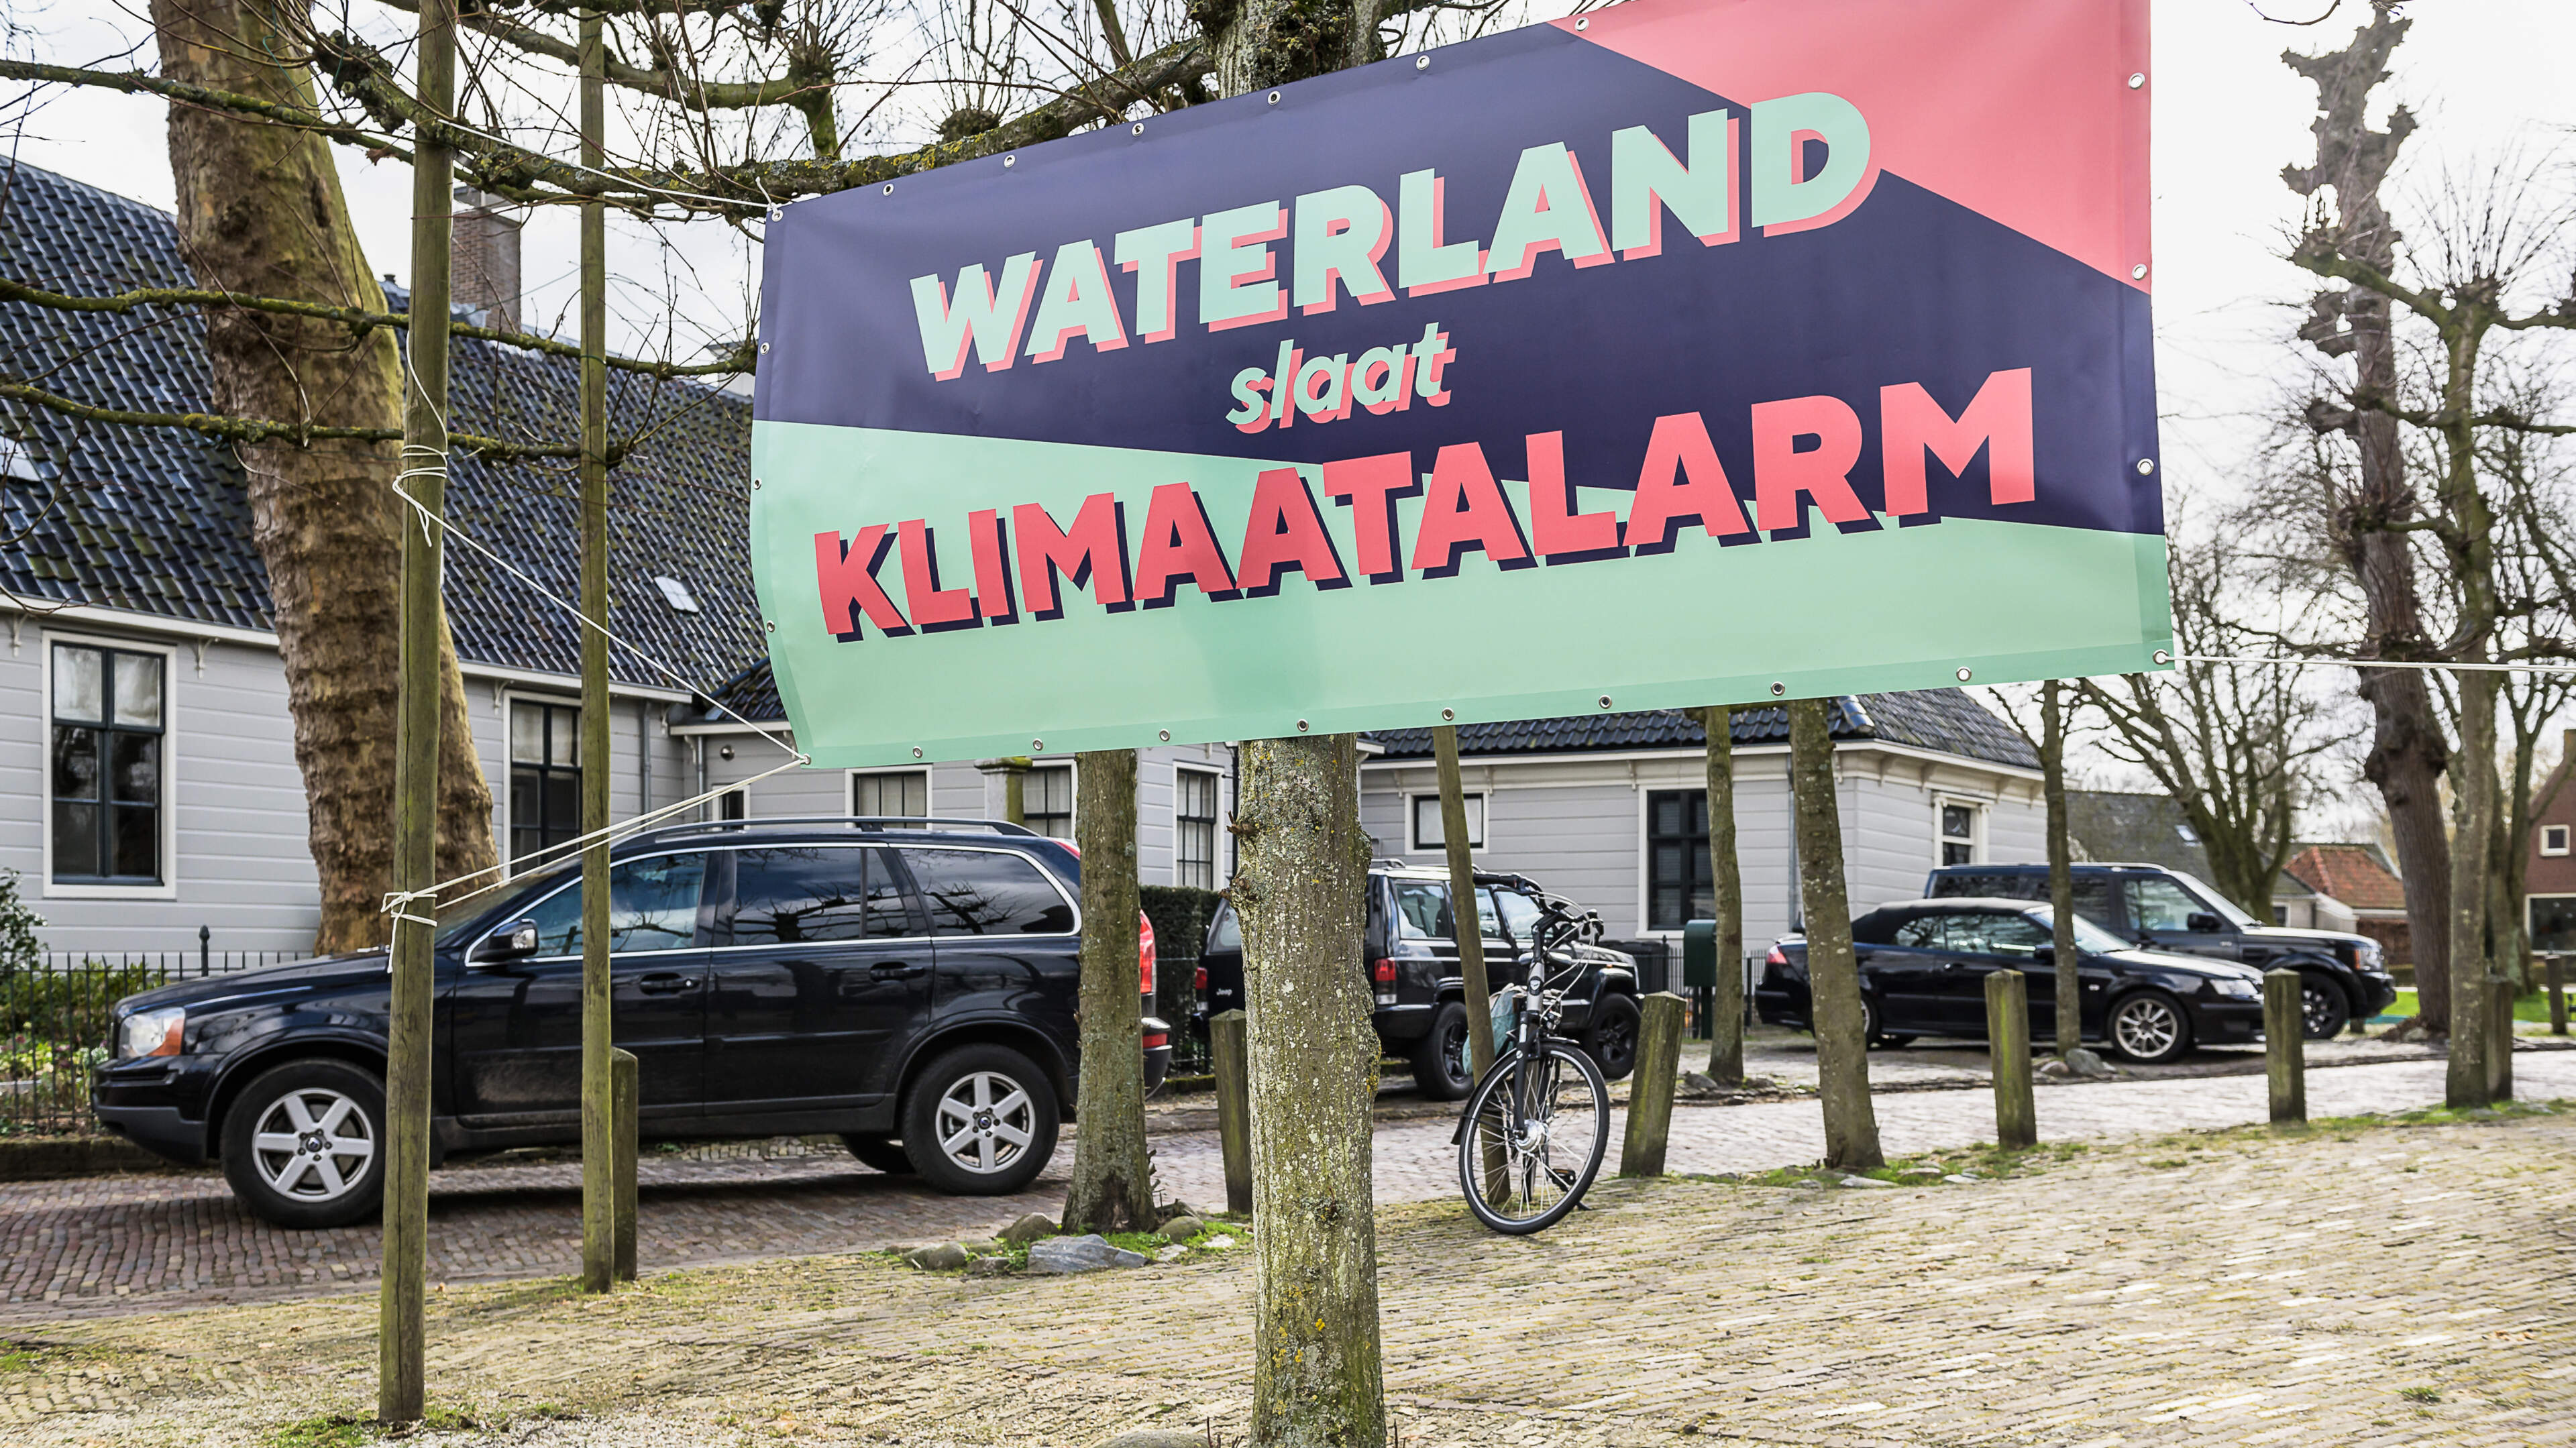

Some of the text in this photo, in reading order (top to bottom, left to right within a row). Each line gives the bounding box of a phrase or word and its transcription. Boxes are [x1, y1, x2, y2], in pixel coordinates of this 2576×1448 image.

[910, 92, 1880, 382] WATERLAND
[814, 367, 2035, 643] KLIMAATALARM
[1225, 322, 1456, 434] slaat
